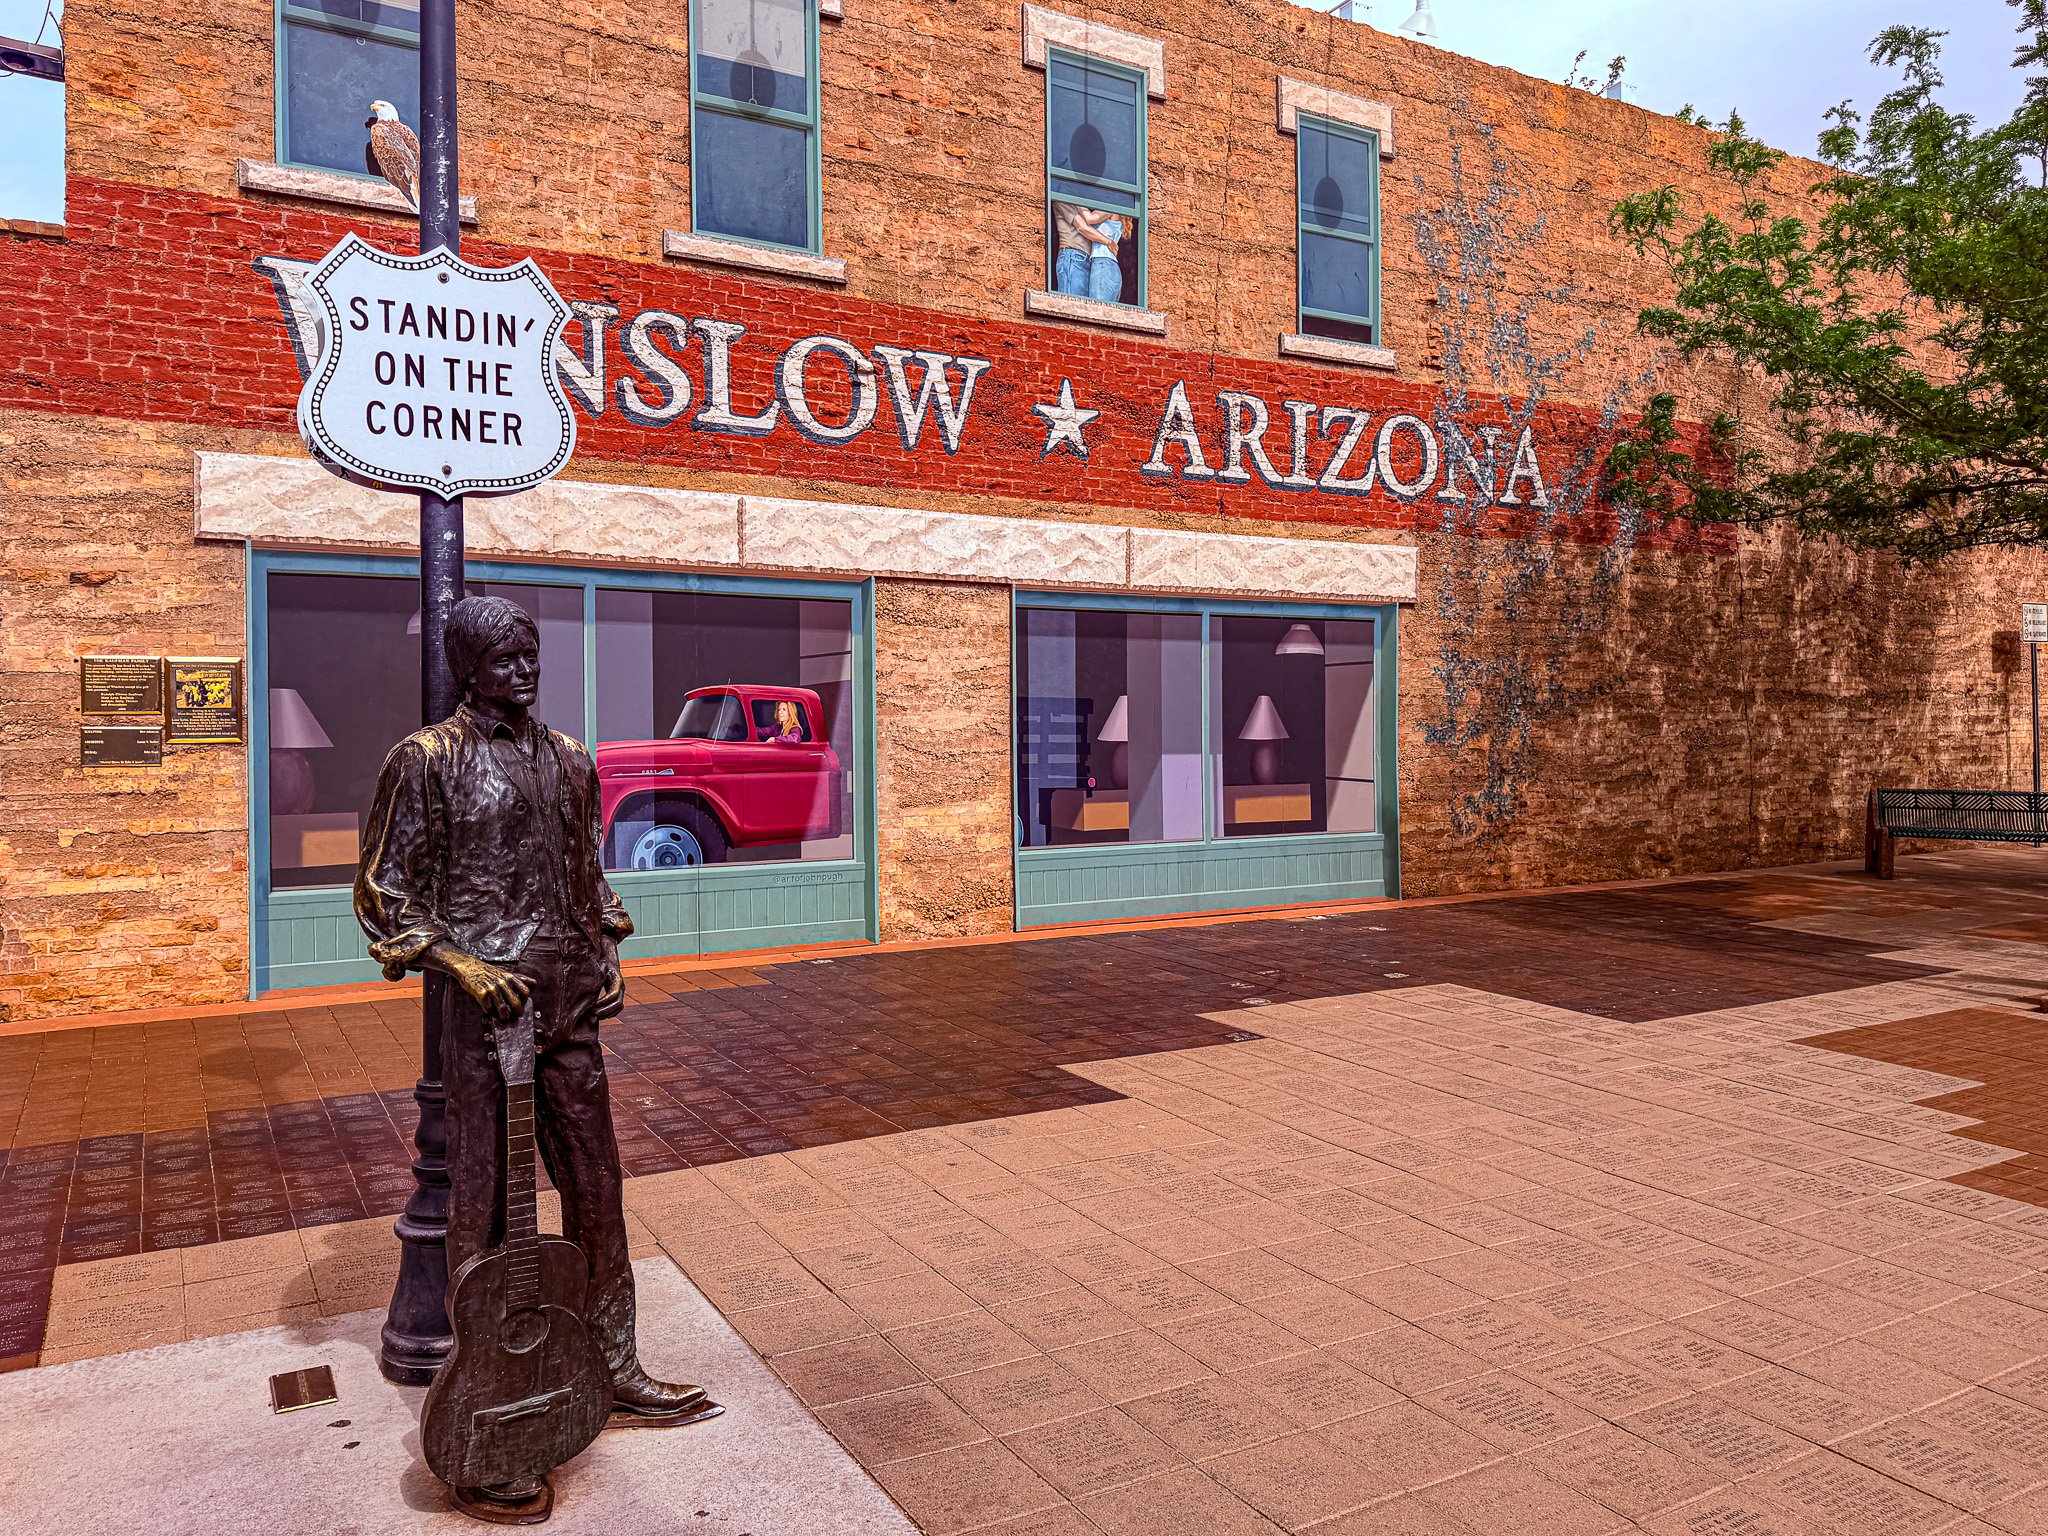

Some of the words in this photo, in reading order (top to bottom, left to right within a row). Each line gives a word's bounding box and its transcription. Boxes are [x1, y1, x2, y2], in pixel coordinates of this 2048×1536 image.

[349, 296, 535, 348] STANDIN'
[375, 351, 425, 388] ON
[443, 357, 513, 397] THE
[366, 400, 522, 446] CORNER
[1140, 378, 1548, 508] ARIZONA
